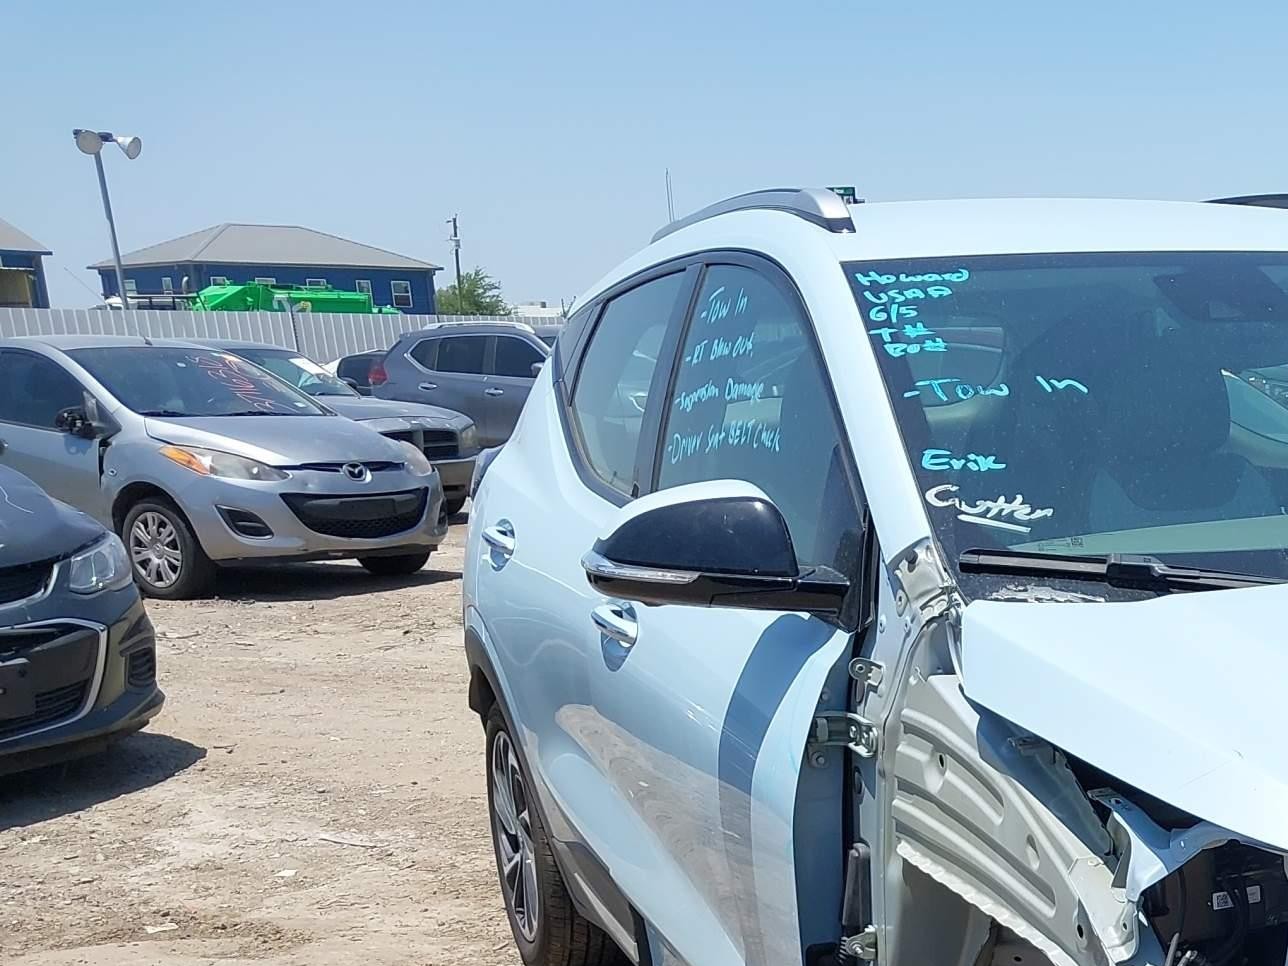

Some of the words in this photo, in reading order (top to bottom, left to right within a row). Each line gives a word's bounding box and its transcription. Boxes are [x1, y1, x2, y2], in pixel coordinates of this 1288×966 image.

[863, 285, 953, 304] USAA
[869, 303, 919, 323] 6/5
[921, 449, 1007, 472] Erik
